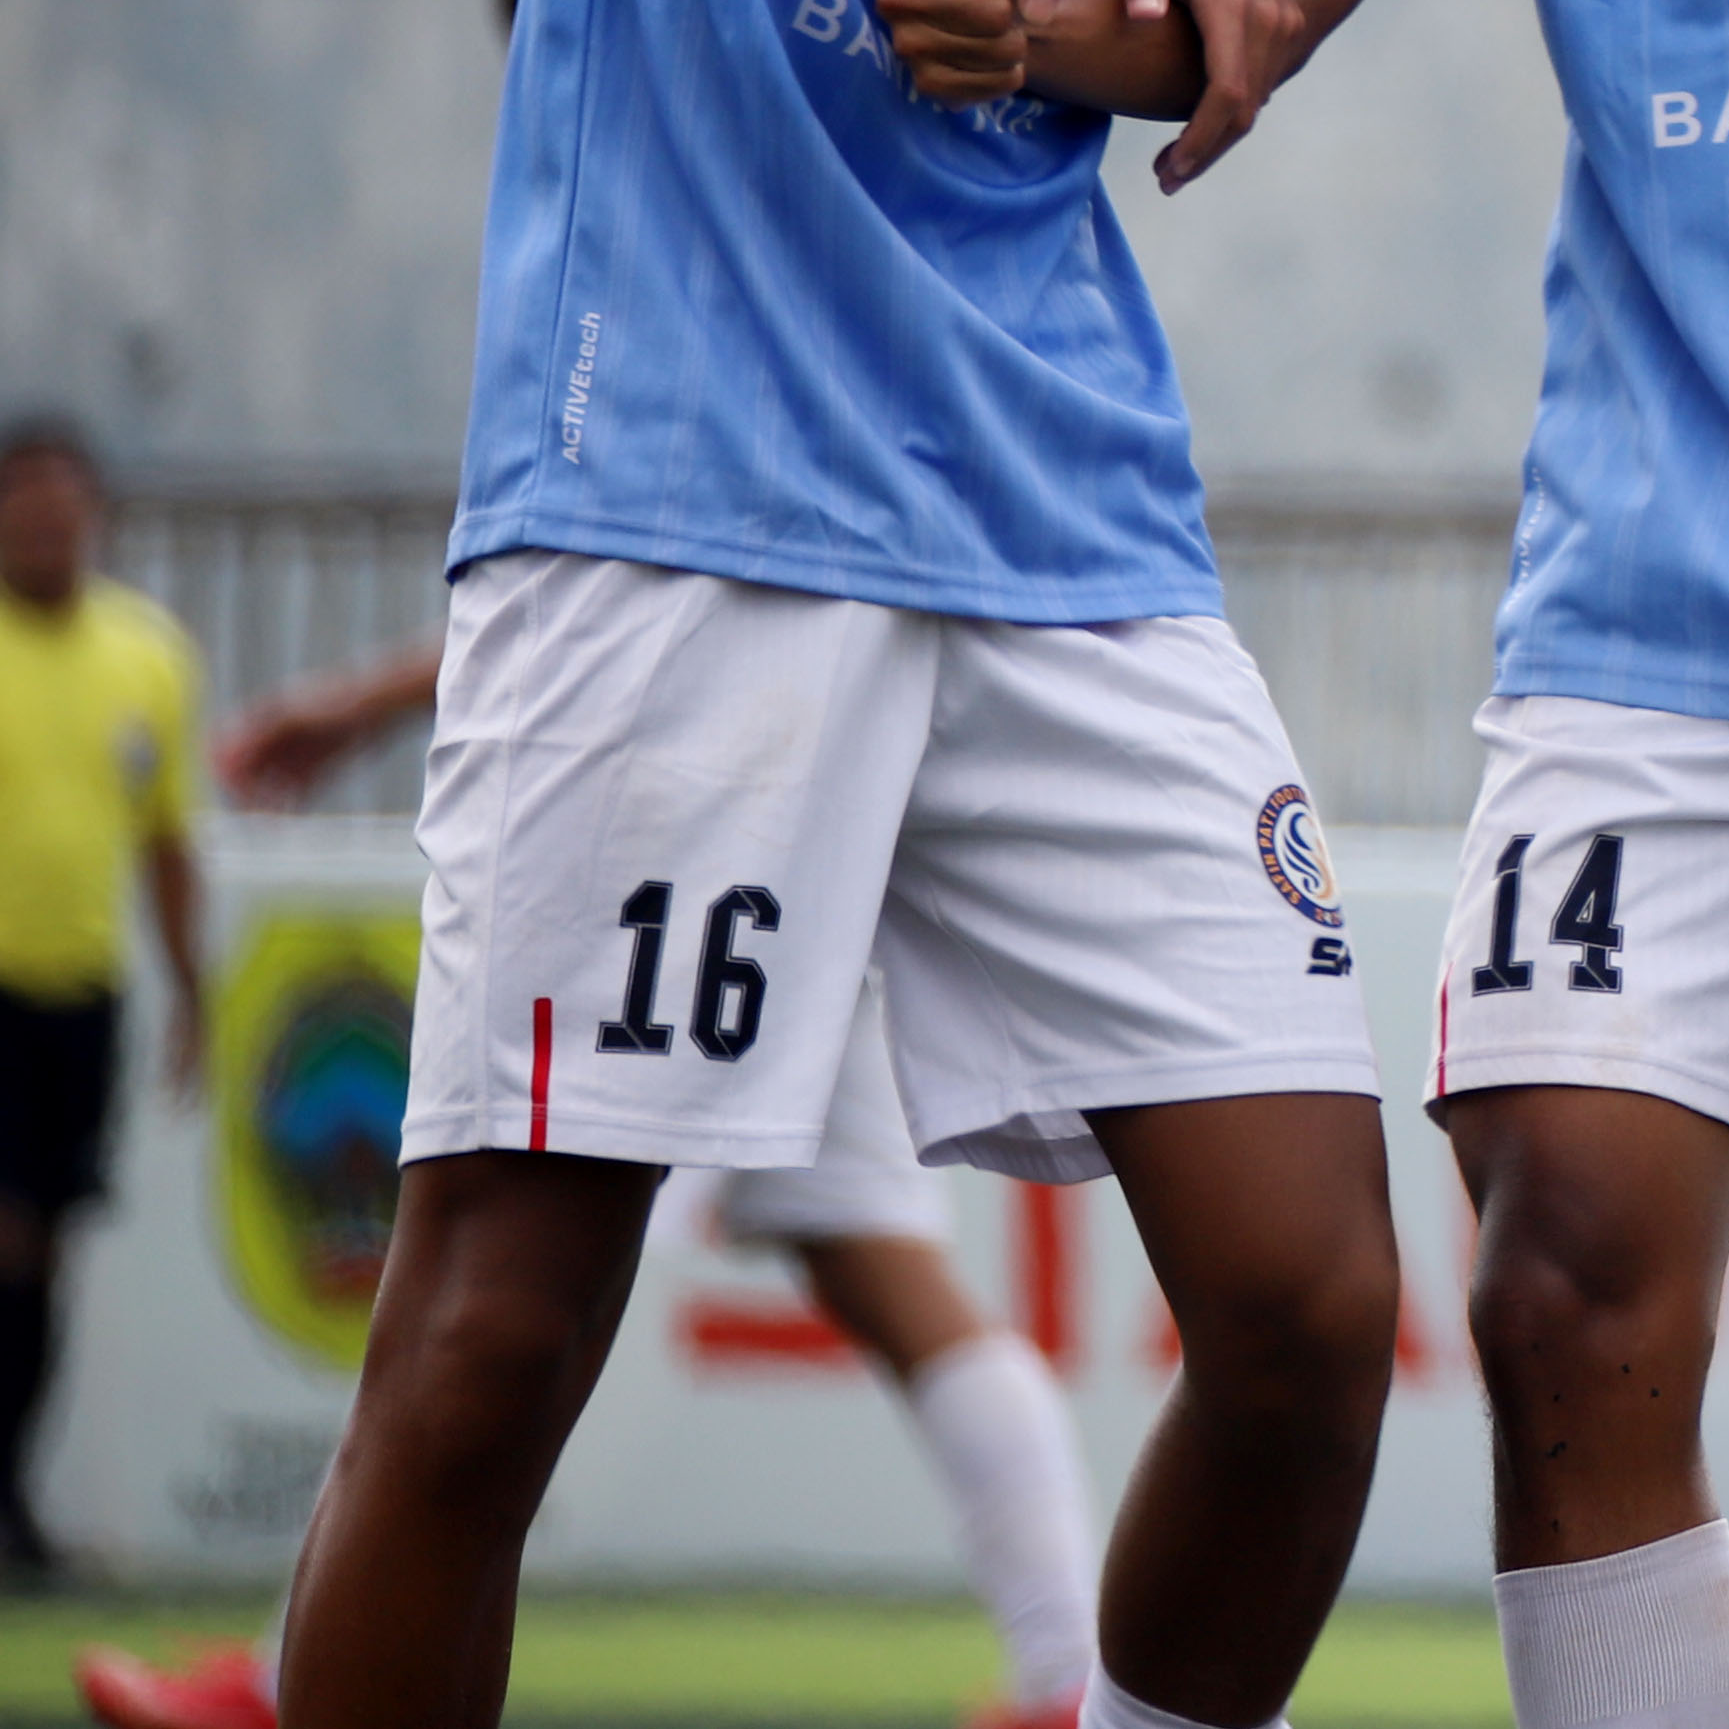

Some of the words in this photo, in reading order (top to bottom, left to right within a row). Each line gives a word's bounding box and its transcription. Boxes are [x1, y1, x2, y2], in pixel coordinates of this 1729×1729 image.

[561, 310, 602, 465] ACTIVEtech
[1258, 808, 1278, 848] PATI
[1262, 853, 1301, 906] SAFIN
[596, 880, 781, 1062] 16
[1472, 834, 1623, 997] 14
